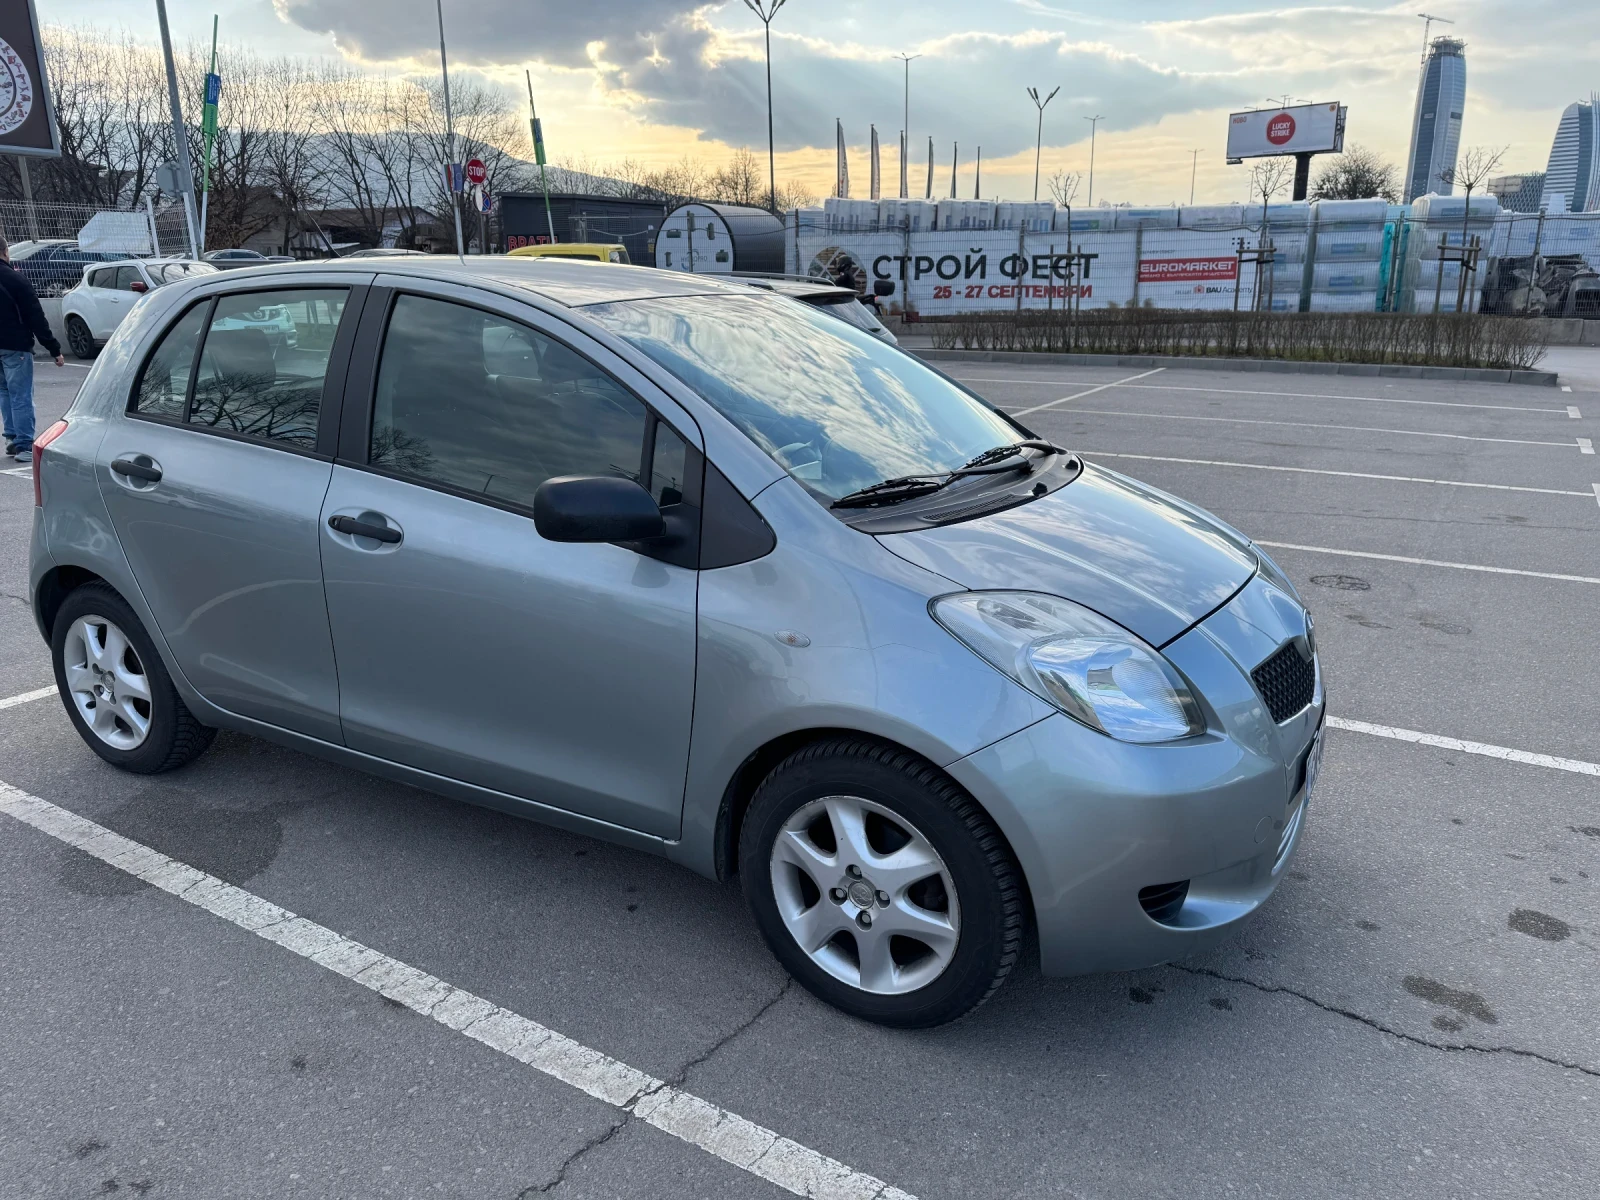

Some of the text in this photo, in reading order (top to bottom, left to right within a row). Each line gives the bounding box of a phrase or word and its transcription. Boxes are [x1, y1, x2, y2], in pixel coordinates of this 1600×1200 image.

[1272, 122, 1291, 130] LUCKY
[1271, 129, 1290, 137] STRIKE
[468, 166, 485, 177] STOP
[872, 248, 1099, 280] СТРОЙ ФЕСТ
[1140, 261, 1235, 272] EUROMARKET
[933, 285, 952, 298] 25
[964, 285, 984, 298] 27
[987, 284, 1092, 299] СЕПТЕМВРИ
